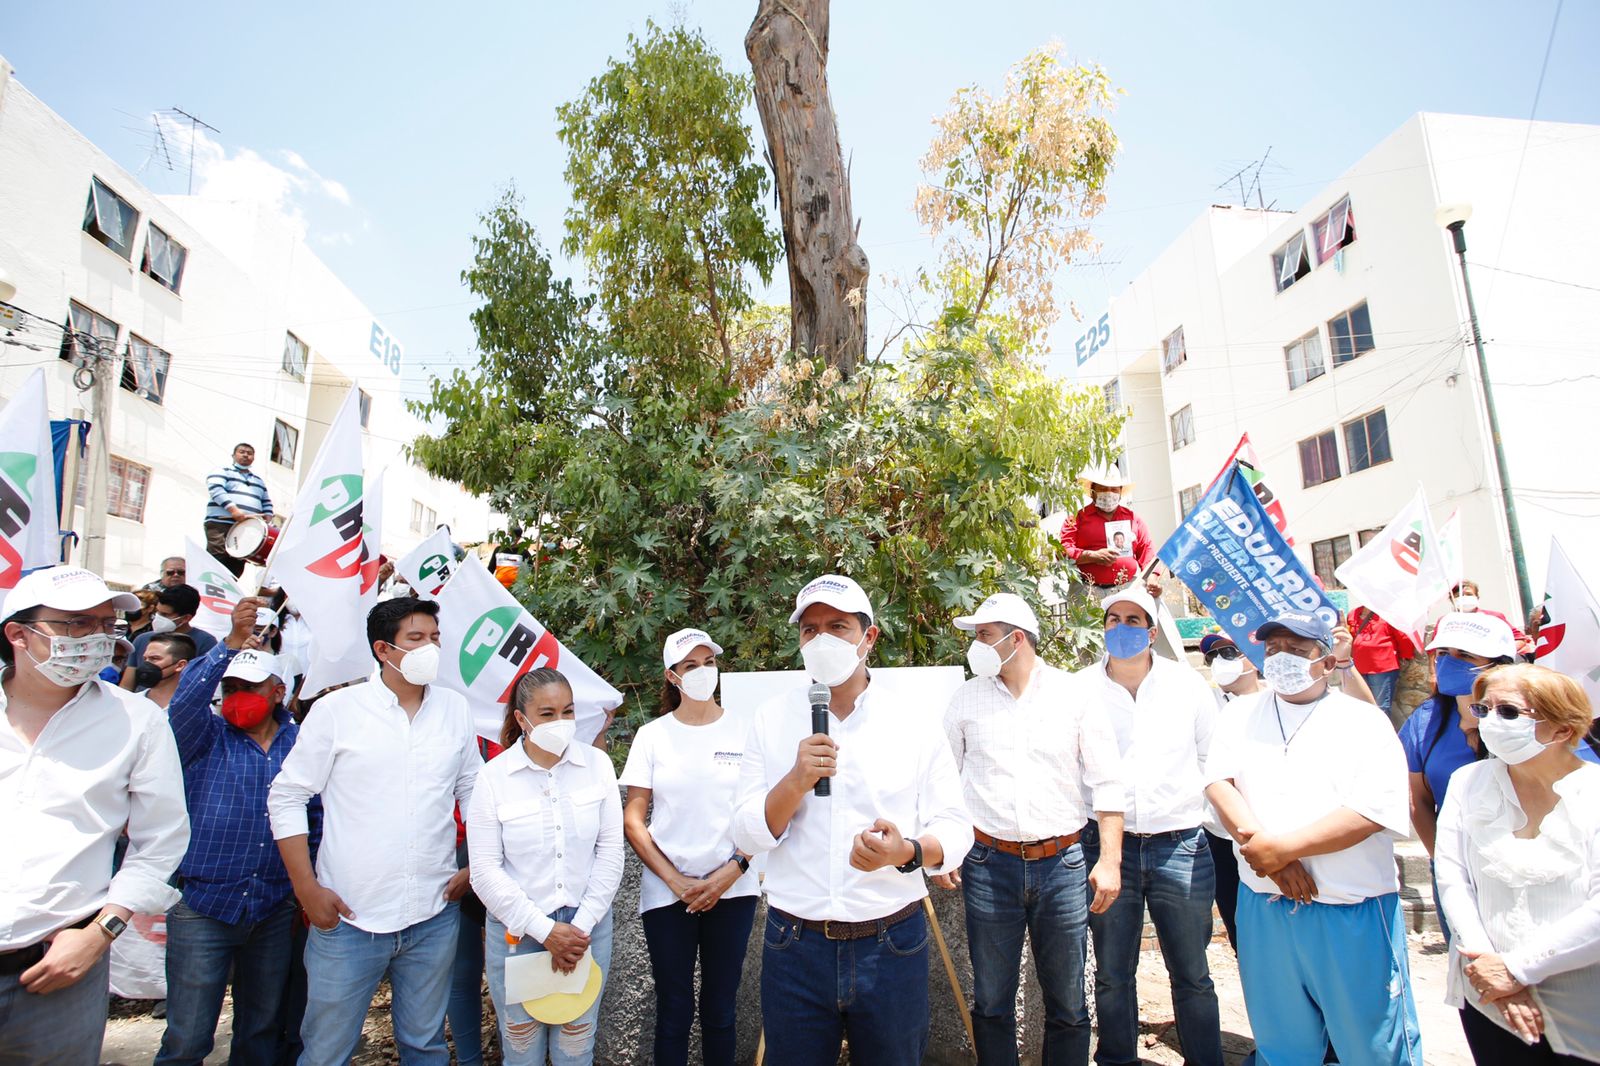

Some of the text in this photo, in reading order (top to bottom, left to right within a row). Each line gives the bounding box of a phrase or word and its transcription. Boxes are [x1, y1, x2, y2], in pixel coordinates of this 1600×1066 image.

[370, 321, 401, 376] E18
[1075, 312, 1110, 367] E25
[1193, 509, 1260, 581] RIVERA
[1207, 543, 1250, 590] PRESIDENTE
[1209, 497, 1338, 629] EDUARDO
